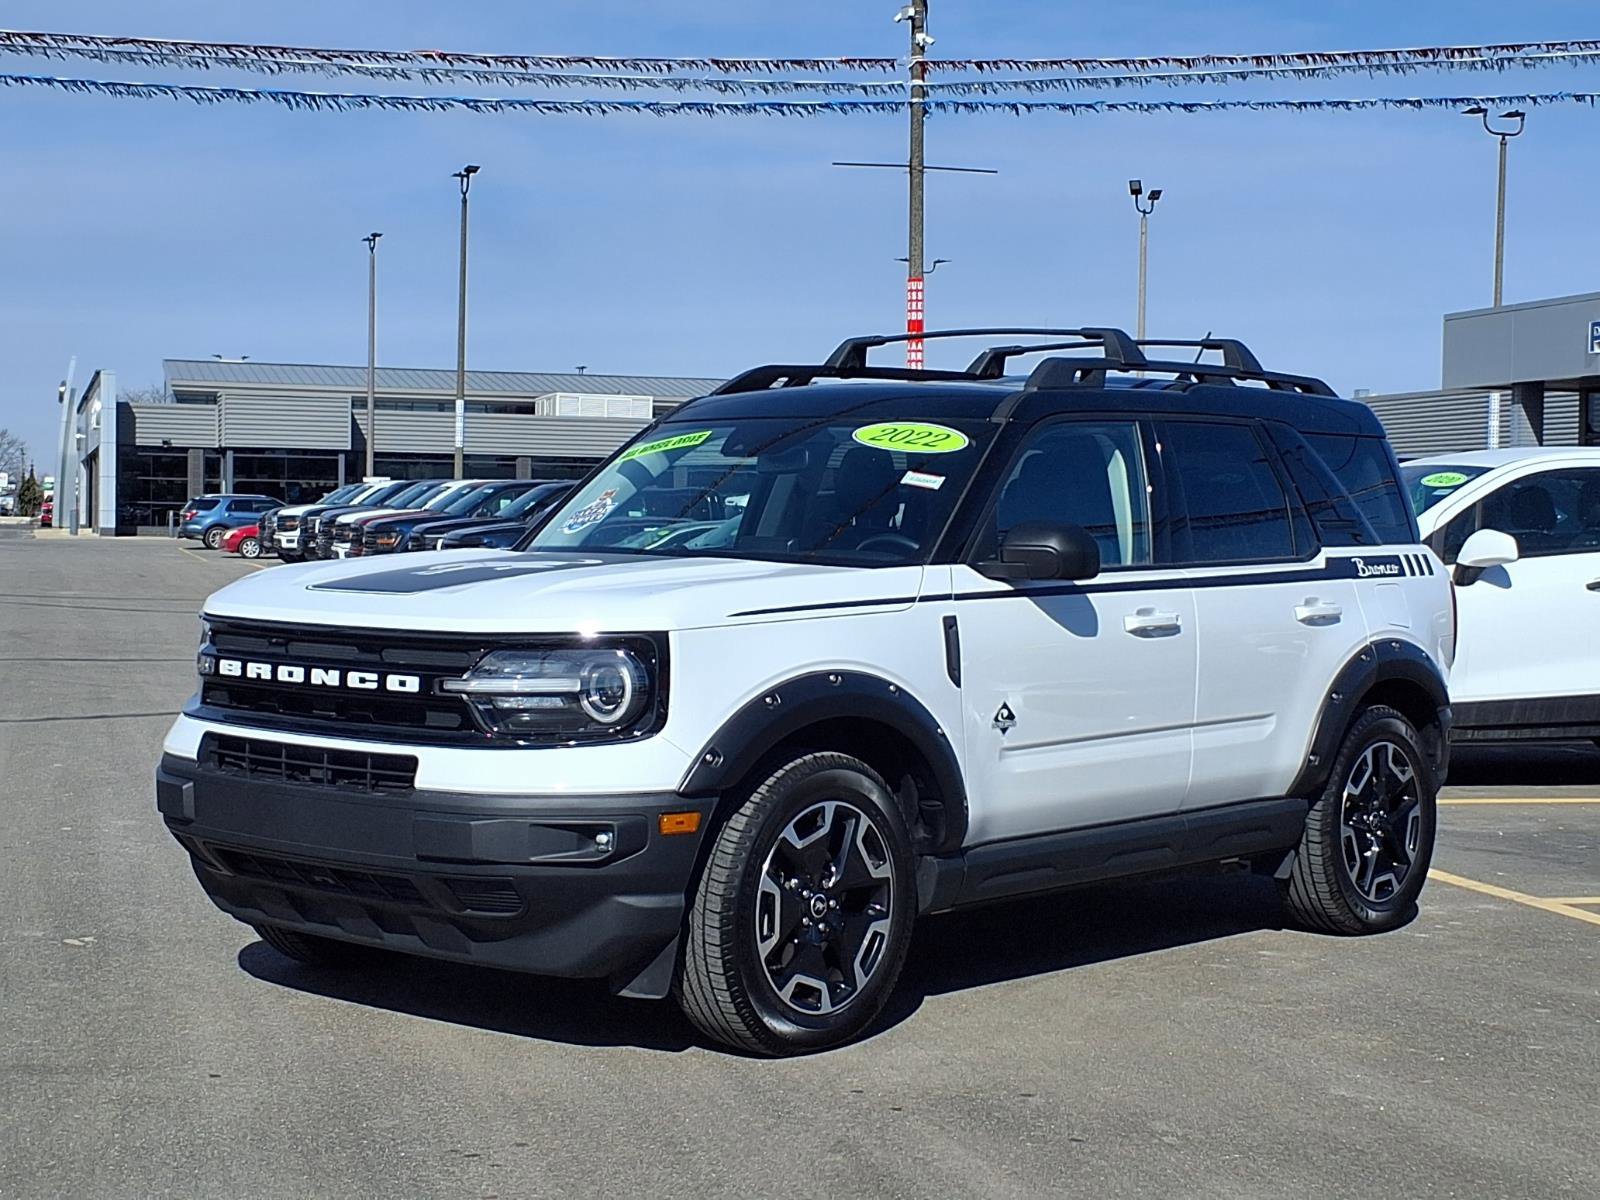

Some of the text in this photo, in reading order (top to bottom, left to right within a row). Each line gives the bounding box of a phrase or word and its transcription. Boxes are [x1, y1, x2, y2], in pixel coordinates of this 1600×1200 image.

[868, 427, 951, 447] 2022
[1351, 558, 1399, 577] Bronco
[219, 659, 420, 693] BRONCO
